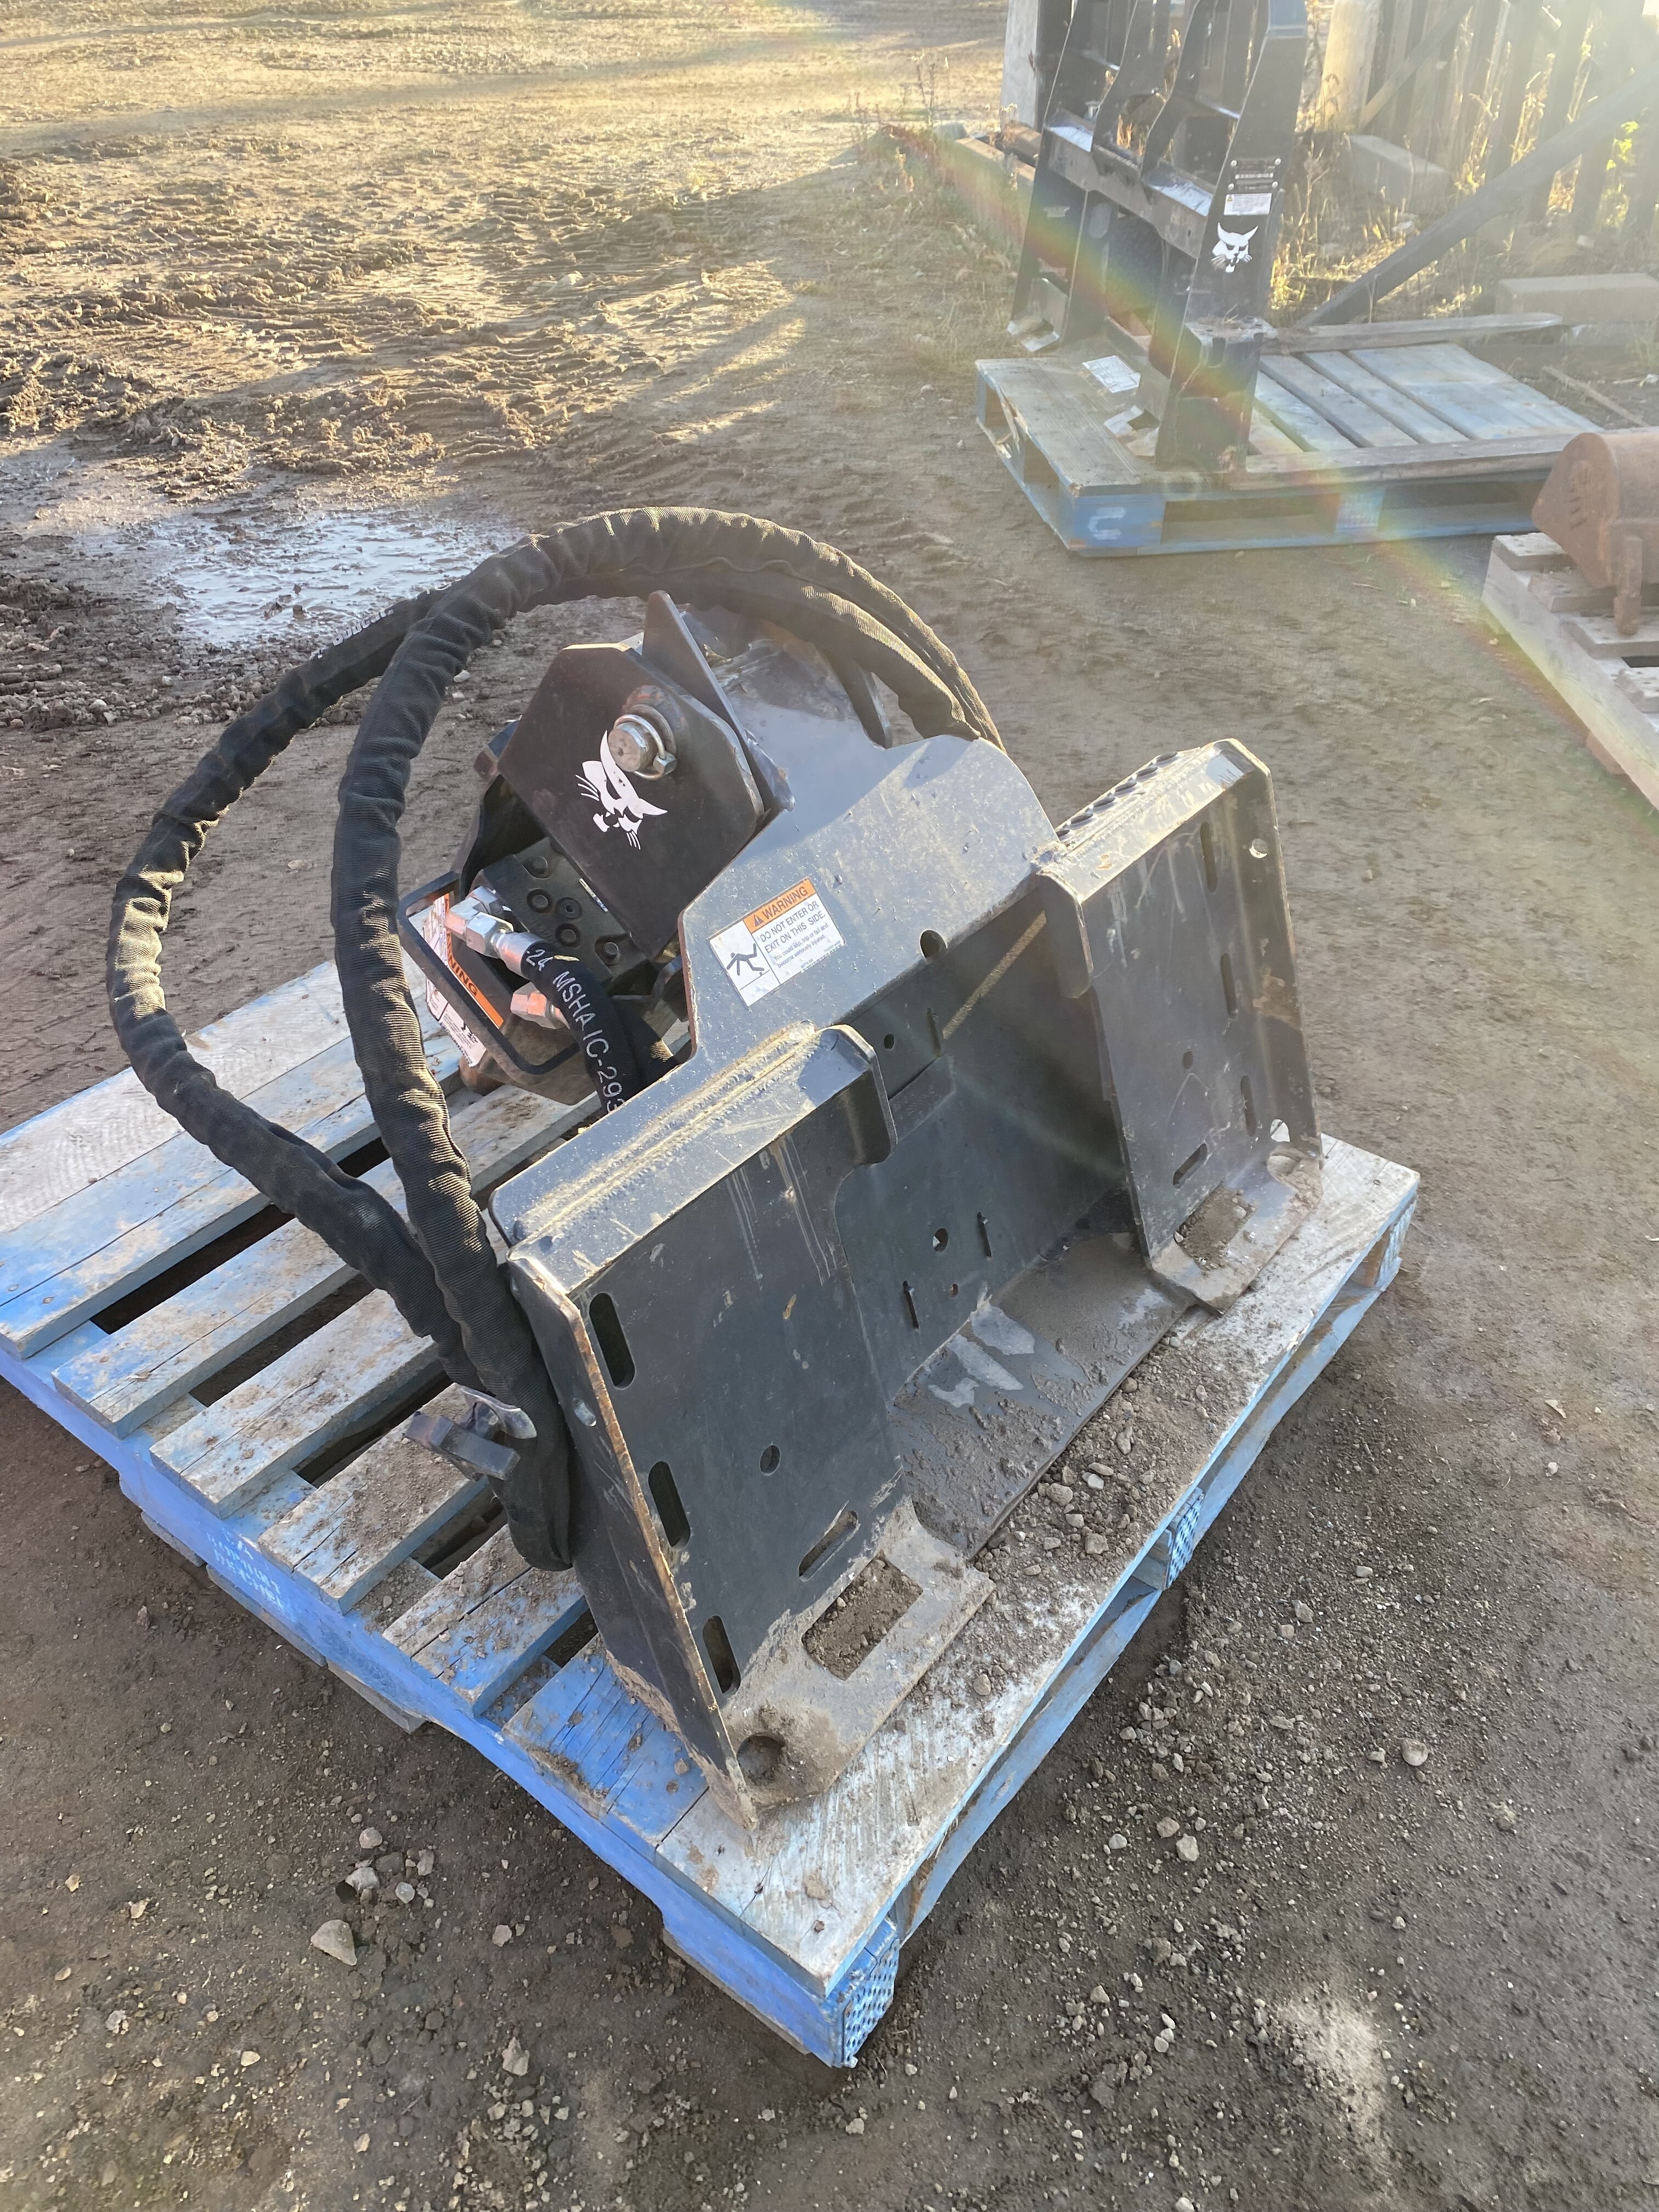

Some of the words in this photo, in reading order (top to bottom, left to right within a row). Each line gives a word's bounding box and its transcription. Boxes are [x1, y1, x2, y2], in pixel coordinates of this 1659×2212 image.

[761, 886, 808, 919] WARNING
[760, 931, 771, 943] DO
[771, 920, 787, 935] NOT
[786, 908, 809, 926] ENTER
[808, 901, 819, 912] OR
[764, 939, 781, 953] EXIT
[780, 933, 792, 944] ON
[790, 922, 807, 935] THIS
[777, 955, 794, 968] become
[794, 943, 812, 957] seriously
[782, 946, 794, 956] could
[802, 935, 810, 945] trip
[821, 923, 829, 931] and
[552, 970, 596, 1031] MSHA
